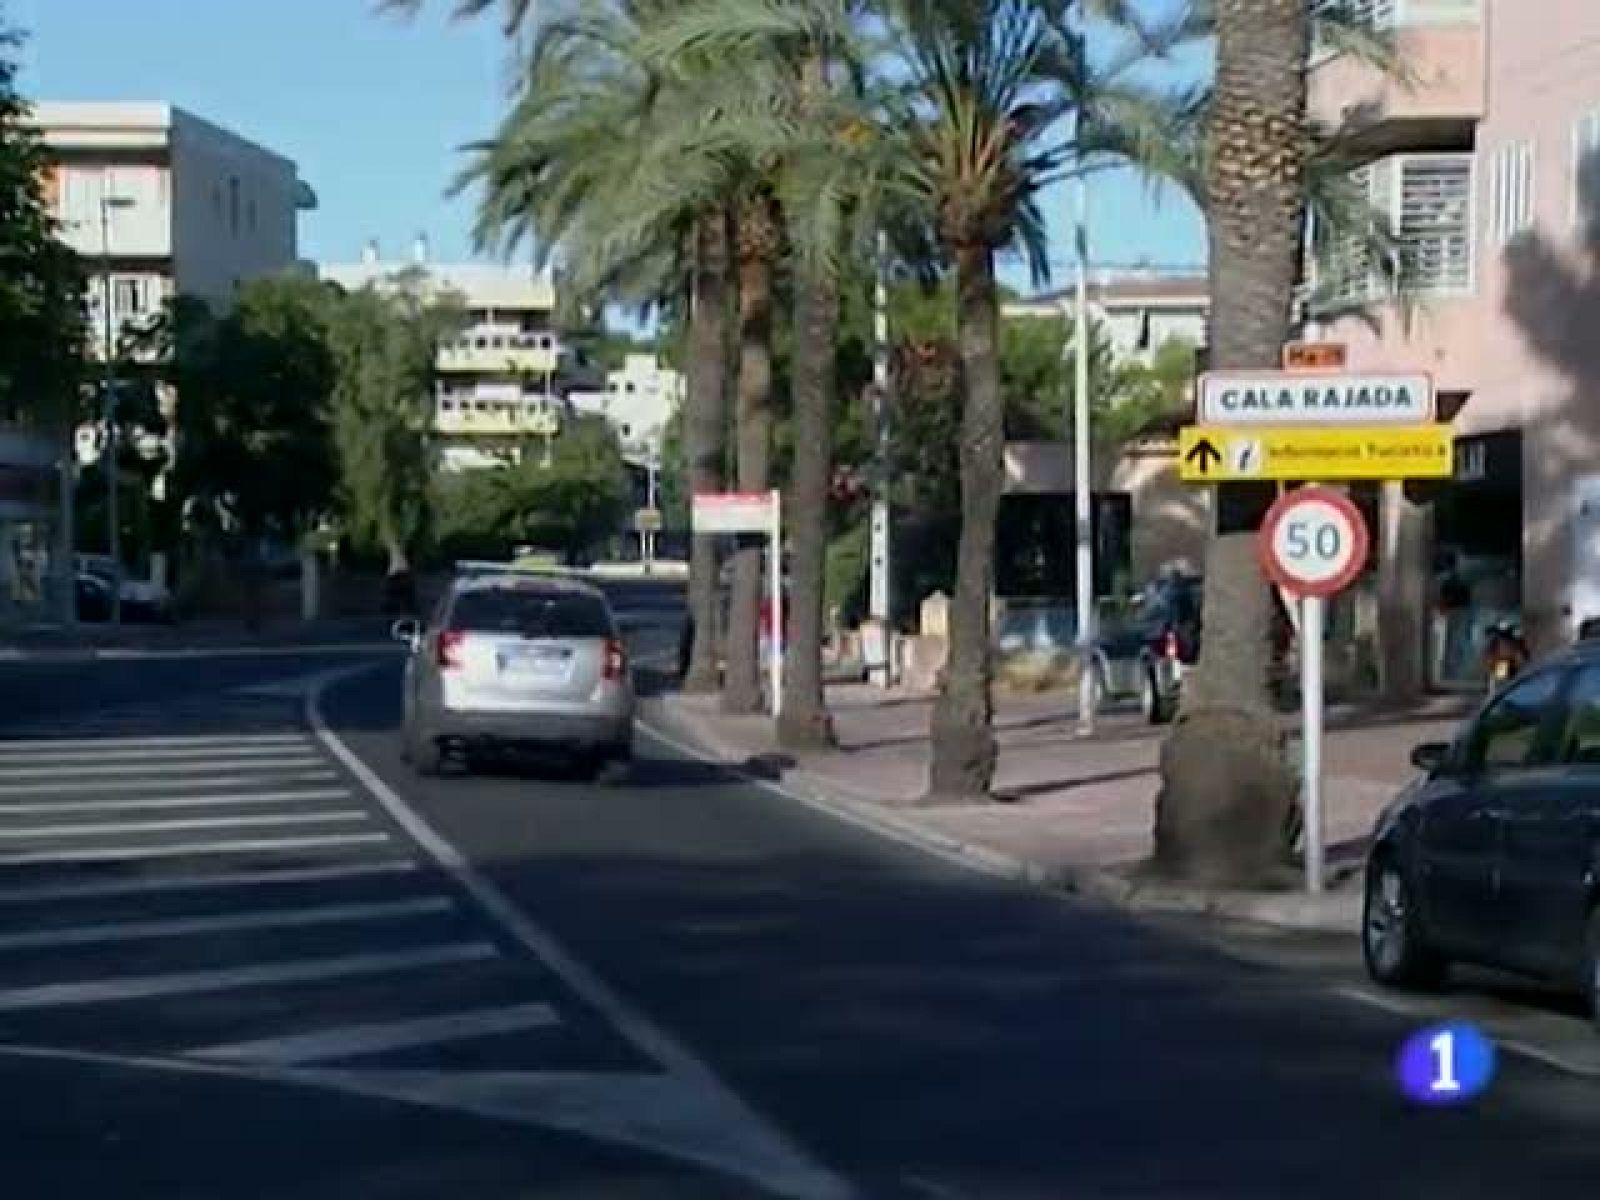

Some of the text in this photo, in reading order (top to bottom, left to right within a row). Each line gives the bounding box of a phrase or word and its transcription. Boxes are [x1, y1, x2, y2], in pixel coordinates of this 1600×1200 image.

[1220, 385, 1411, 411] CALA RAJADA
[1287, 523, 1340, 559] 50
